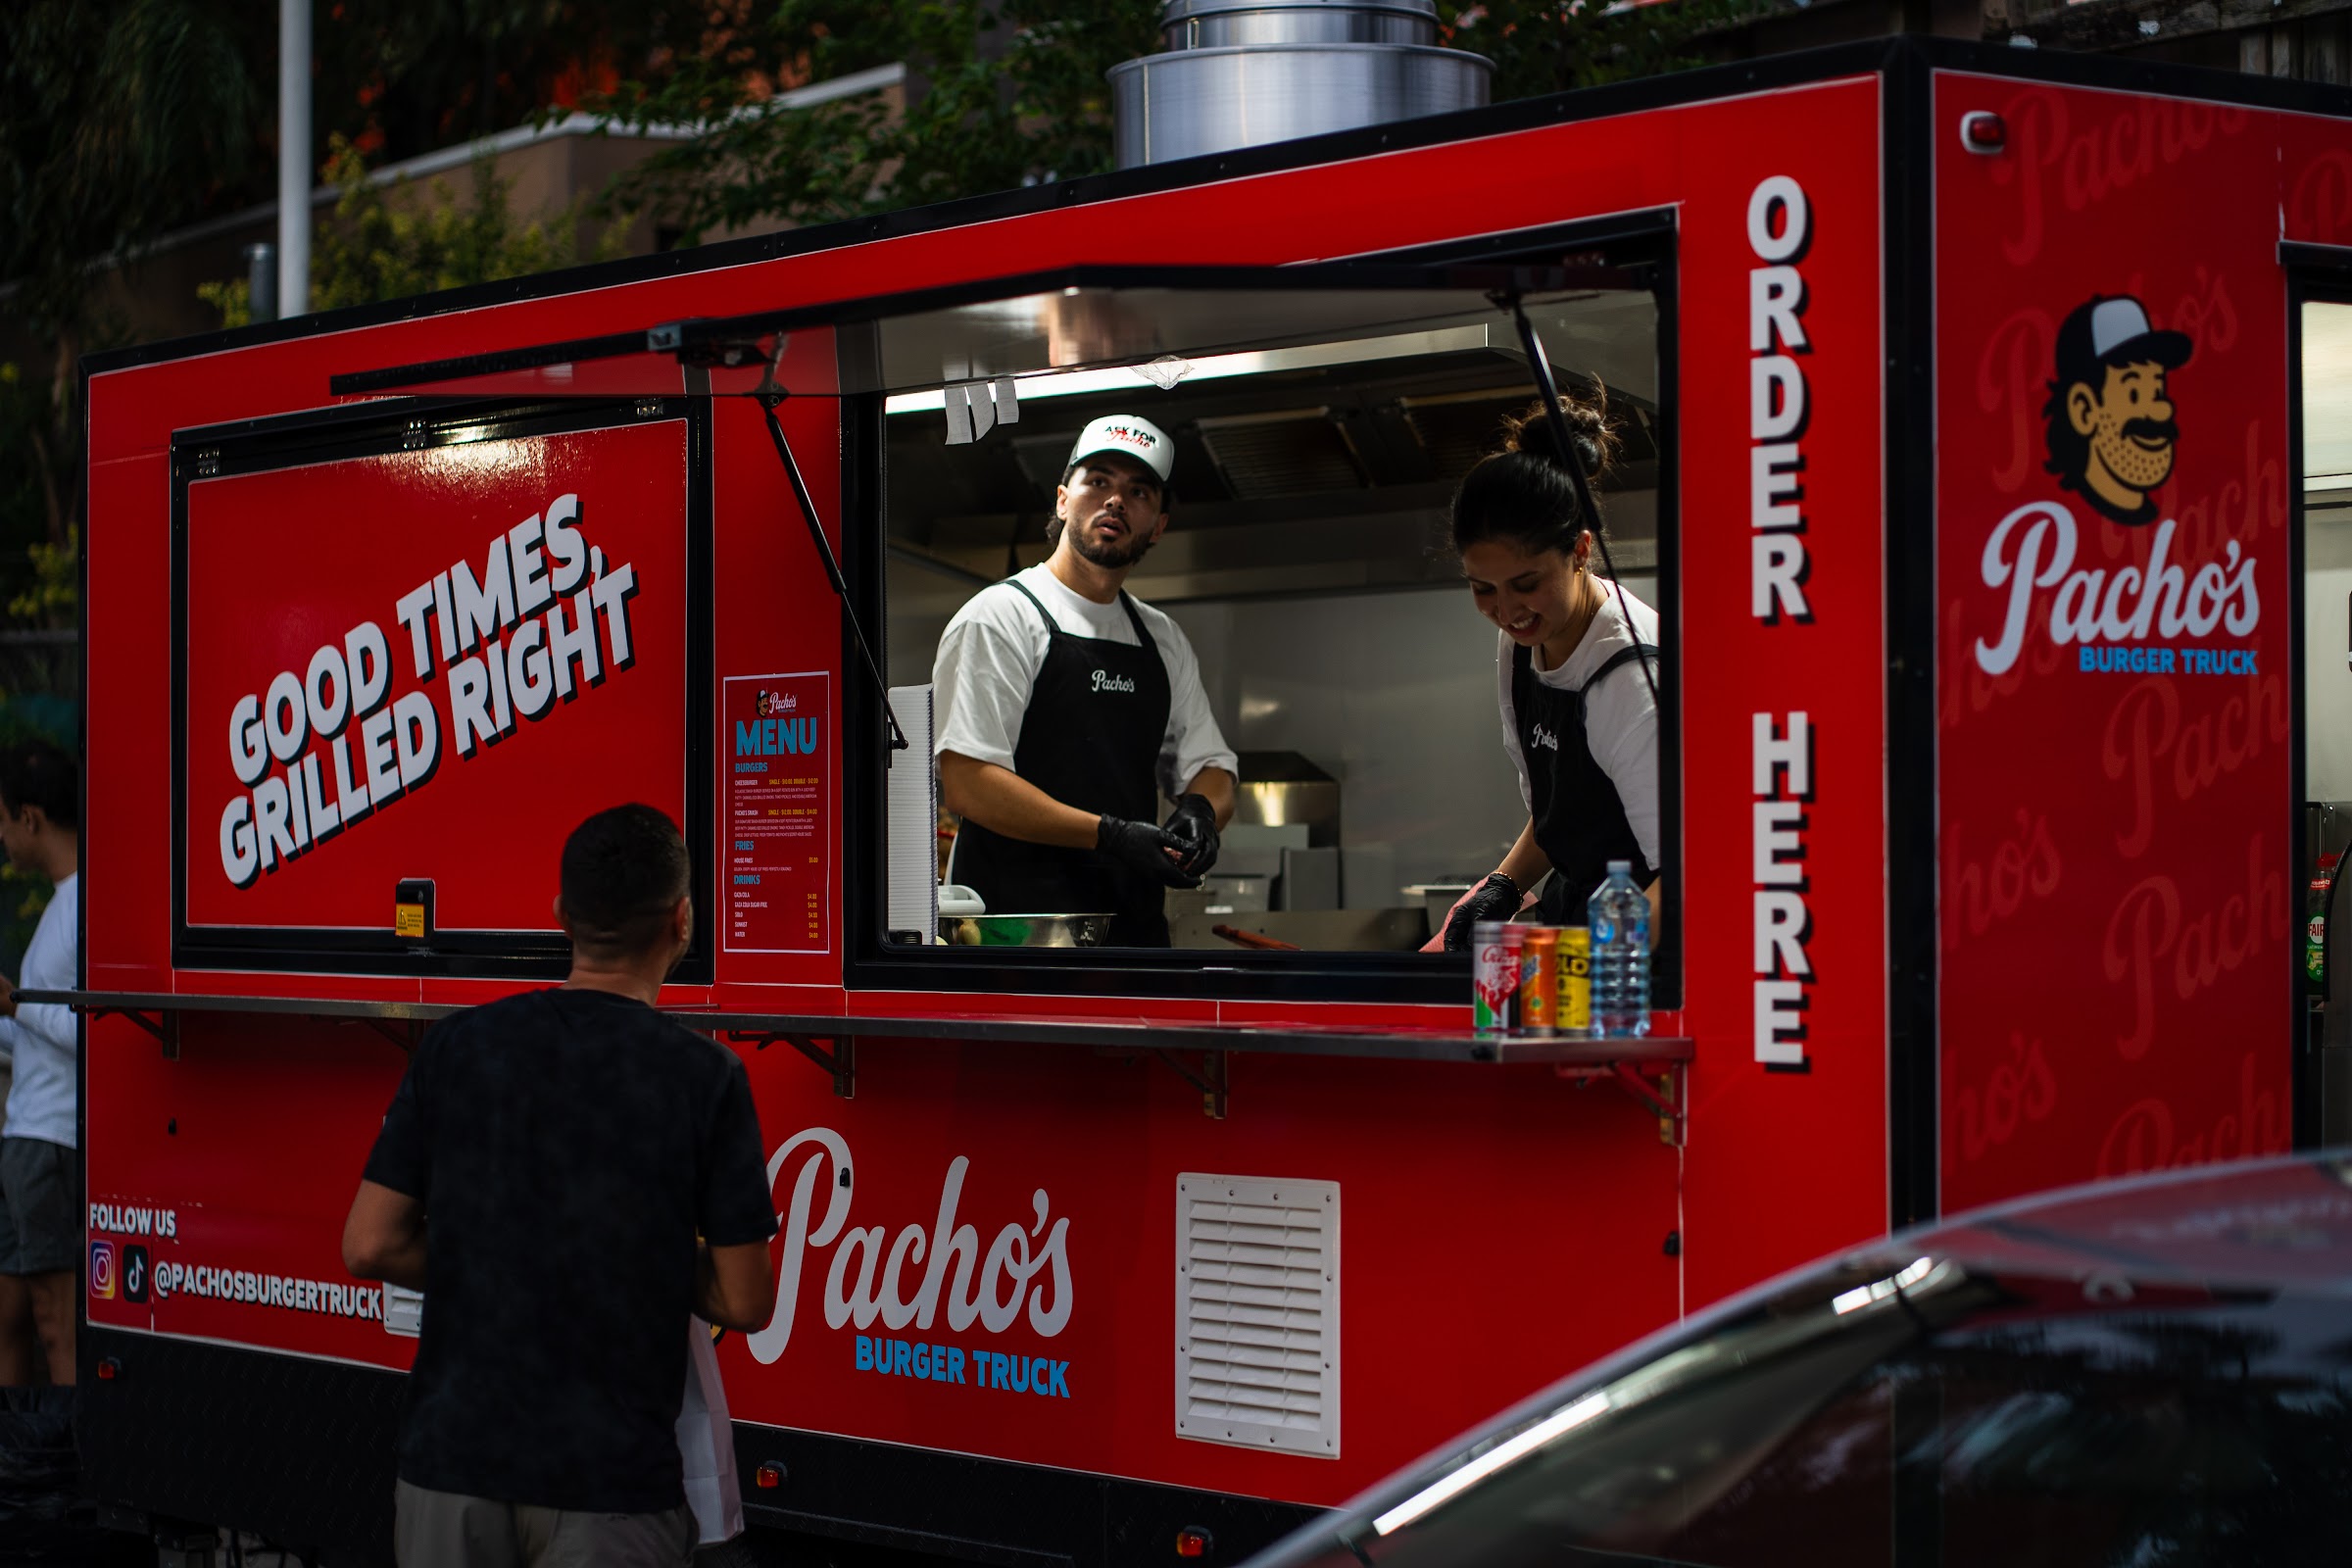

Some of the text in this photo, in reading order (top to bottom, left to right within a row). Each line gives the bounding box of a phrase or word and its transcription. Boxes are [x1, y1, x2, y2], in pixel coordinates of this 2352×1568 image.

[1105, 425, 1156, 444] ASK FOR
[1975, 501, 2261, 675] Pacho's
[1746, 174, 1811, 1064] ORDER HERE
[228, 493, 605, 786] GOOD TIMES,
[2079, 645, 2259, 675] BURGER TRUCK
[1091, 669, 1135, 693] Pacho's
[768, 692, 797, 714] Pacho's
[220, 562, 635, 887] GRILLED RIGHT
[736, 717, 817, 757] MENU
[735, 761, 768, 773] BURGERS
[735, 840, 754, 852] FRIES
[734, 874, 760, 885] DRINKS
[2308, 923, 2325, 937] FAIR
[89, 1202, 177, 1239] FOLLOW US
[746, 1126, 1074, 1365] Pacho's
[154, 1260, 383, 1321] @PACHOSBURGERTRUCK
[855, 1334, 1071, 1399] BURGER TRUCK
